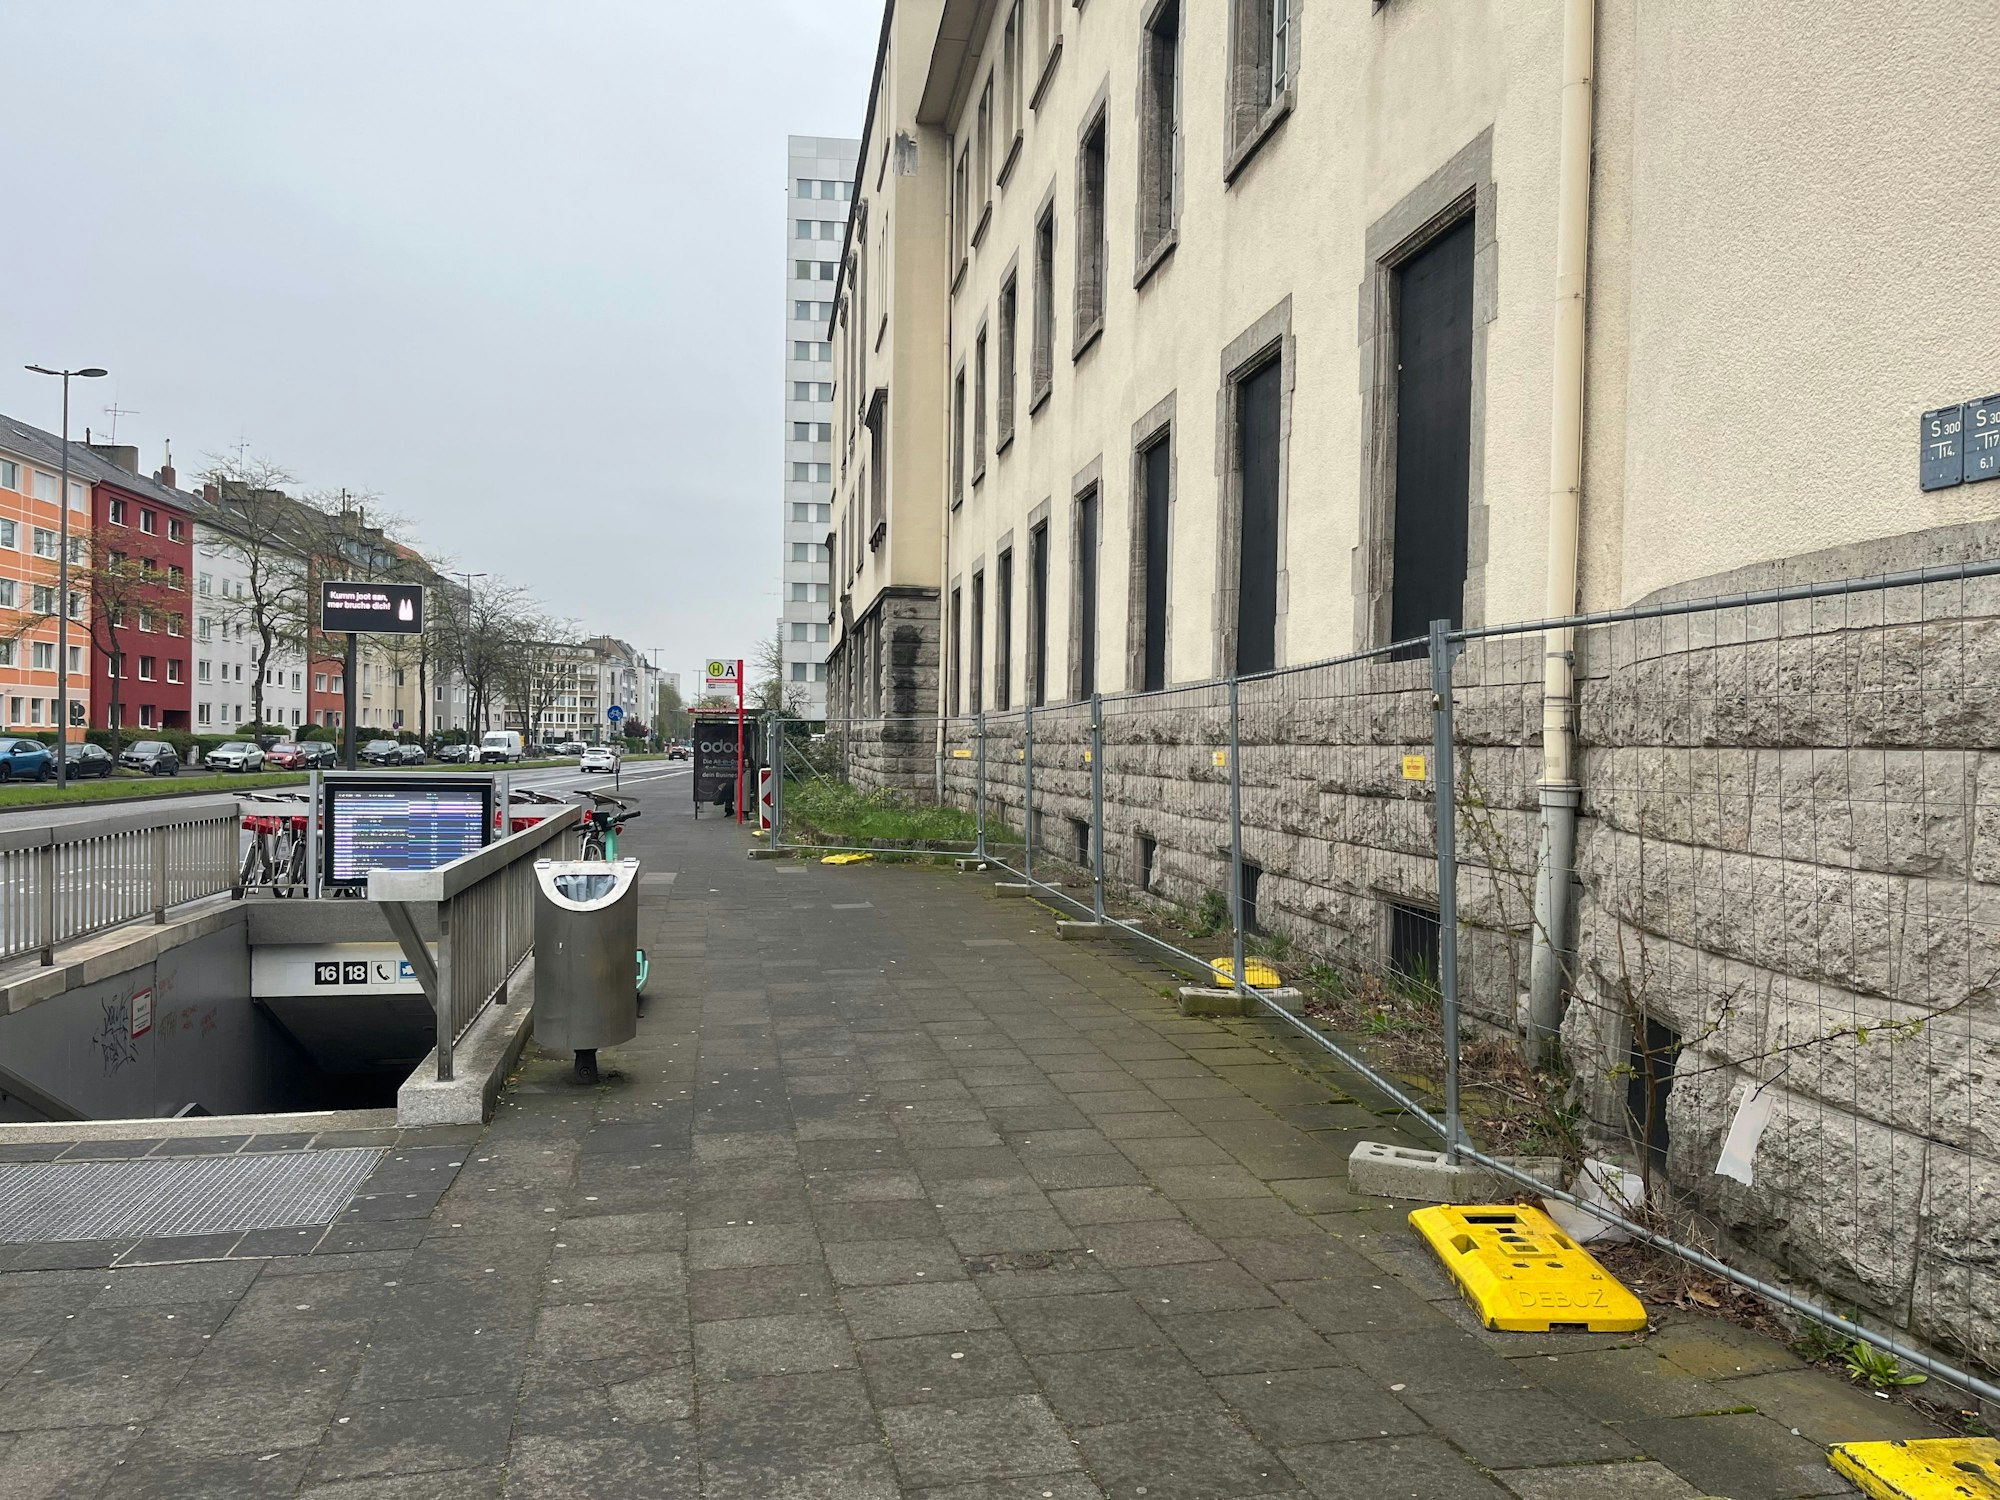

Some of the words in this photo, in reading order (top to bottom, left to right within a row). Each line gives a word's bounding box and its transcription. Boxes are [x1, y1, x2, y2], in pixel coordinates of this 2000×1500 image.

[1976, 409, 1987, 427] S
[1931, 420, 1942, 438] S
[1943, 421, 1961, 435] 300
[330, 591, 355, 600] Kumm
[355, 592, 371, 601] joot
[344, 601, 371, 609] bruche
[372, 602, 391, 610] dich!
[712, 664, 720, 674] H
[725, 665, 736, 677] A
[700, 738, 745, 753] odoo
[317, 966, 338, 981] 16
[345, 965, 366, 981] 18
[1518, 1289, 1609, 1308] DEBUZ
